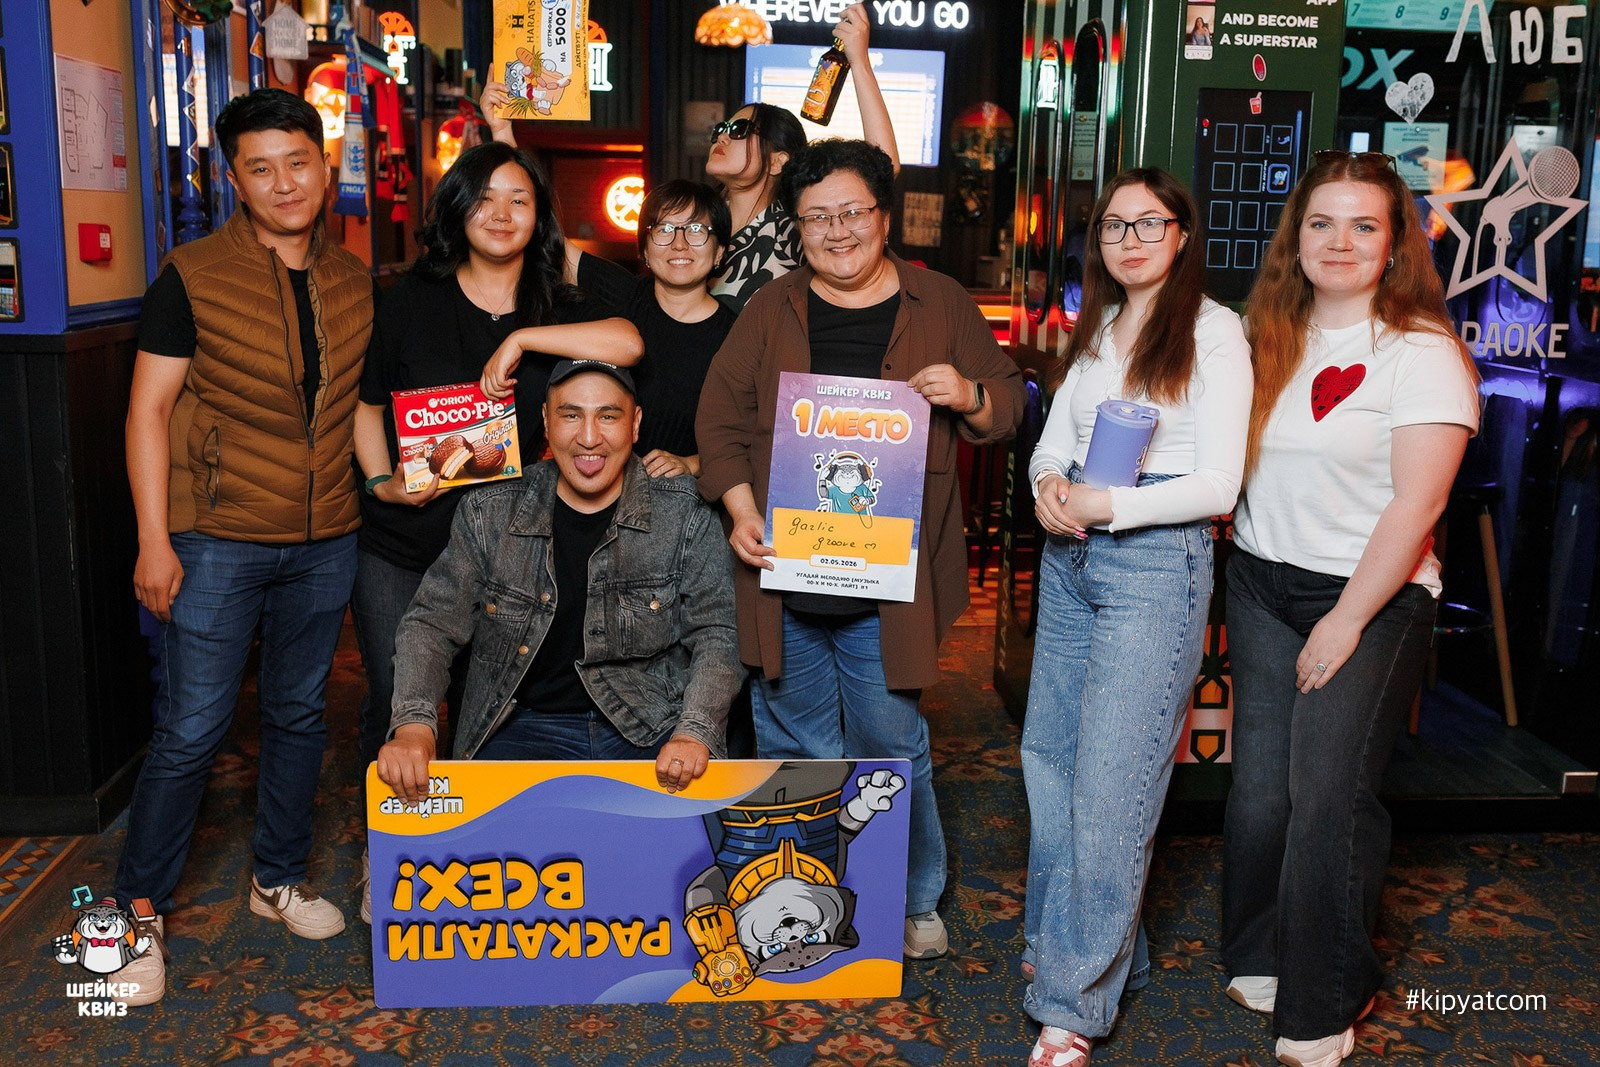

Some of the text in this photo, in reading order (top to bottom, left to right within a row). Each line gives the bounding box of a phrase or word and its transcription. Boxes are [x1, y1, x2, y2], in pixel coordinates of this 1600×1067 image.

[873, 0, 925, 28] YOU
[934, 1, 970, 29] GO
[1351, 3, 1361, 17] 7
[1395, 5, 1405, 19] 8
[1439, 7, 1449, 21] 9
[1221, 13, 1319, 29] AND BECOME
[555, 7, 567, 62] НА 5000
[1219, 33, 1318, 49] A SUPERSTAR
[816, 384, 892, 400] ШЕЙКЕР КВИЗ
[440, 395, 474, 406] ORION
[794, 400, 911, 442] 1 МЕСТО
[820, 558, 858, 568] 02.05.2026
[391, 857, 586, 912] ВСЕХ!
[386, 917, 672, 962] РАСКАТАЛИ
